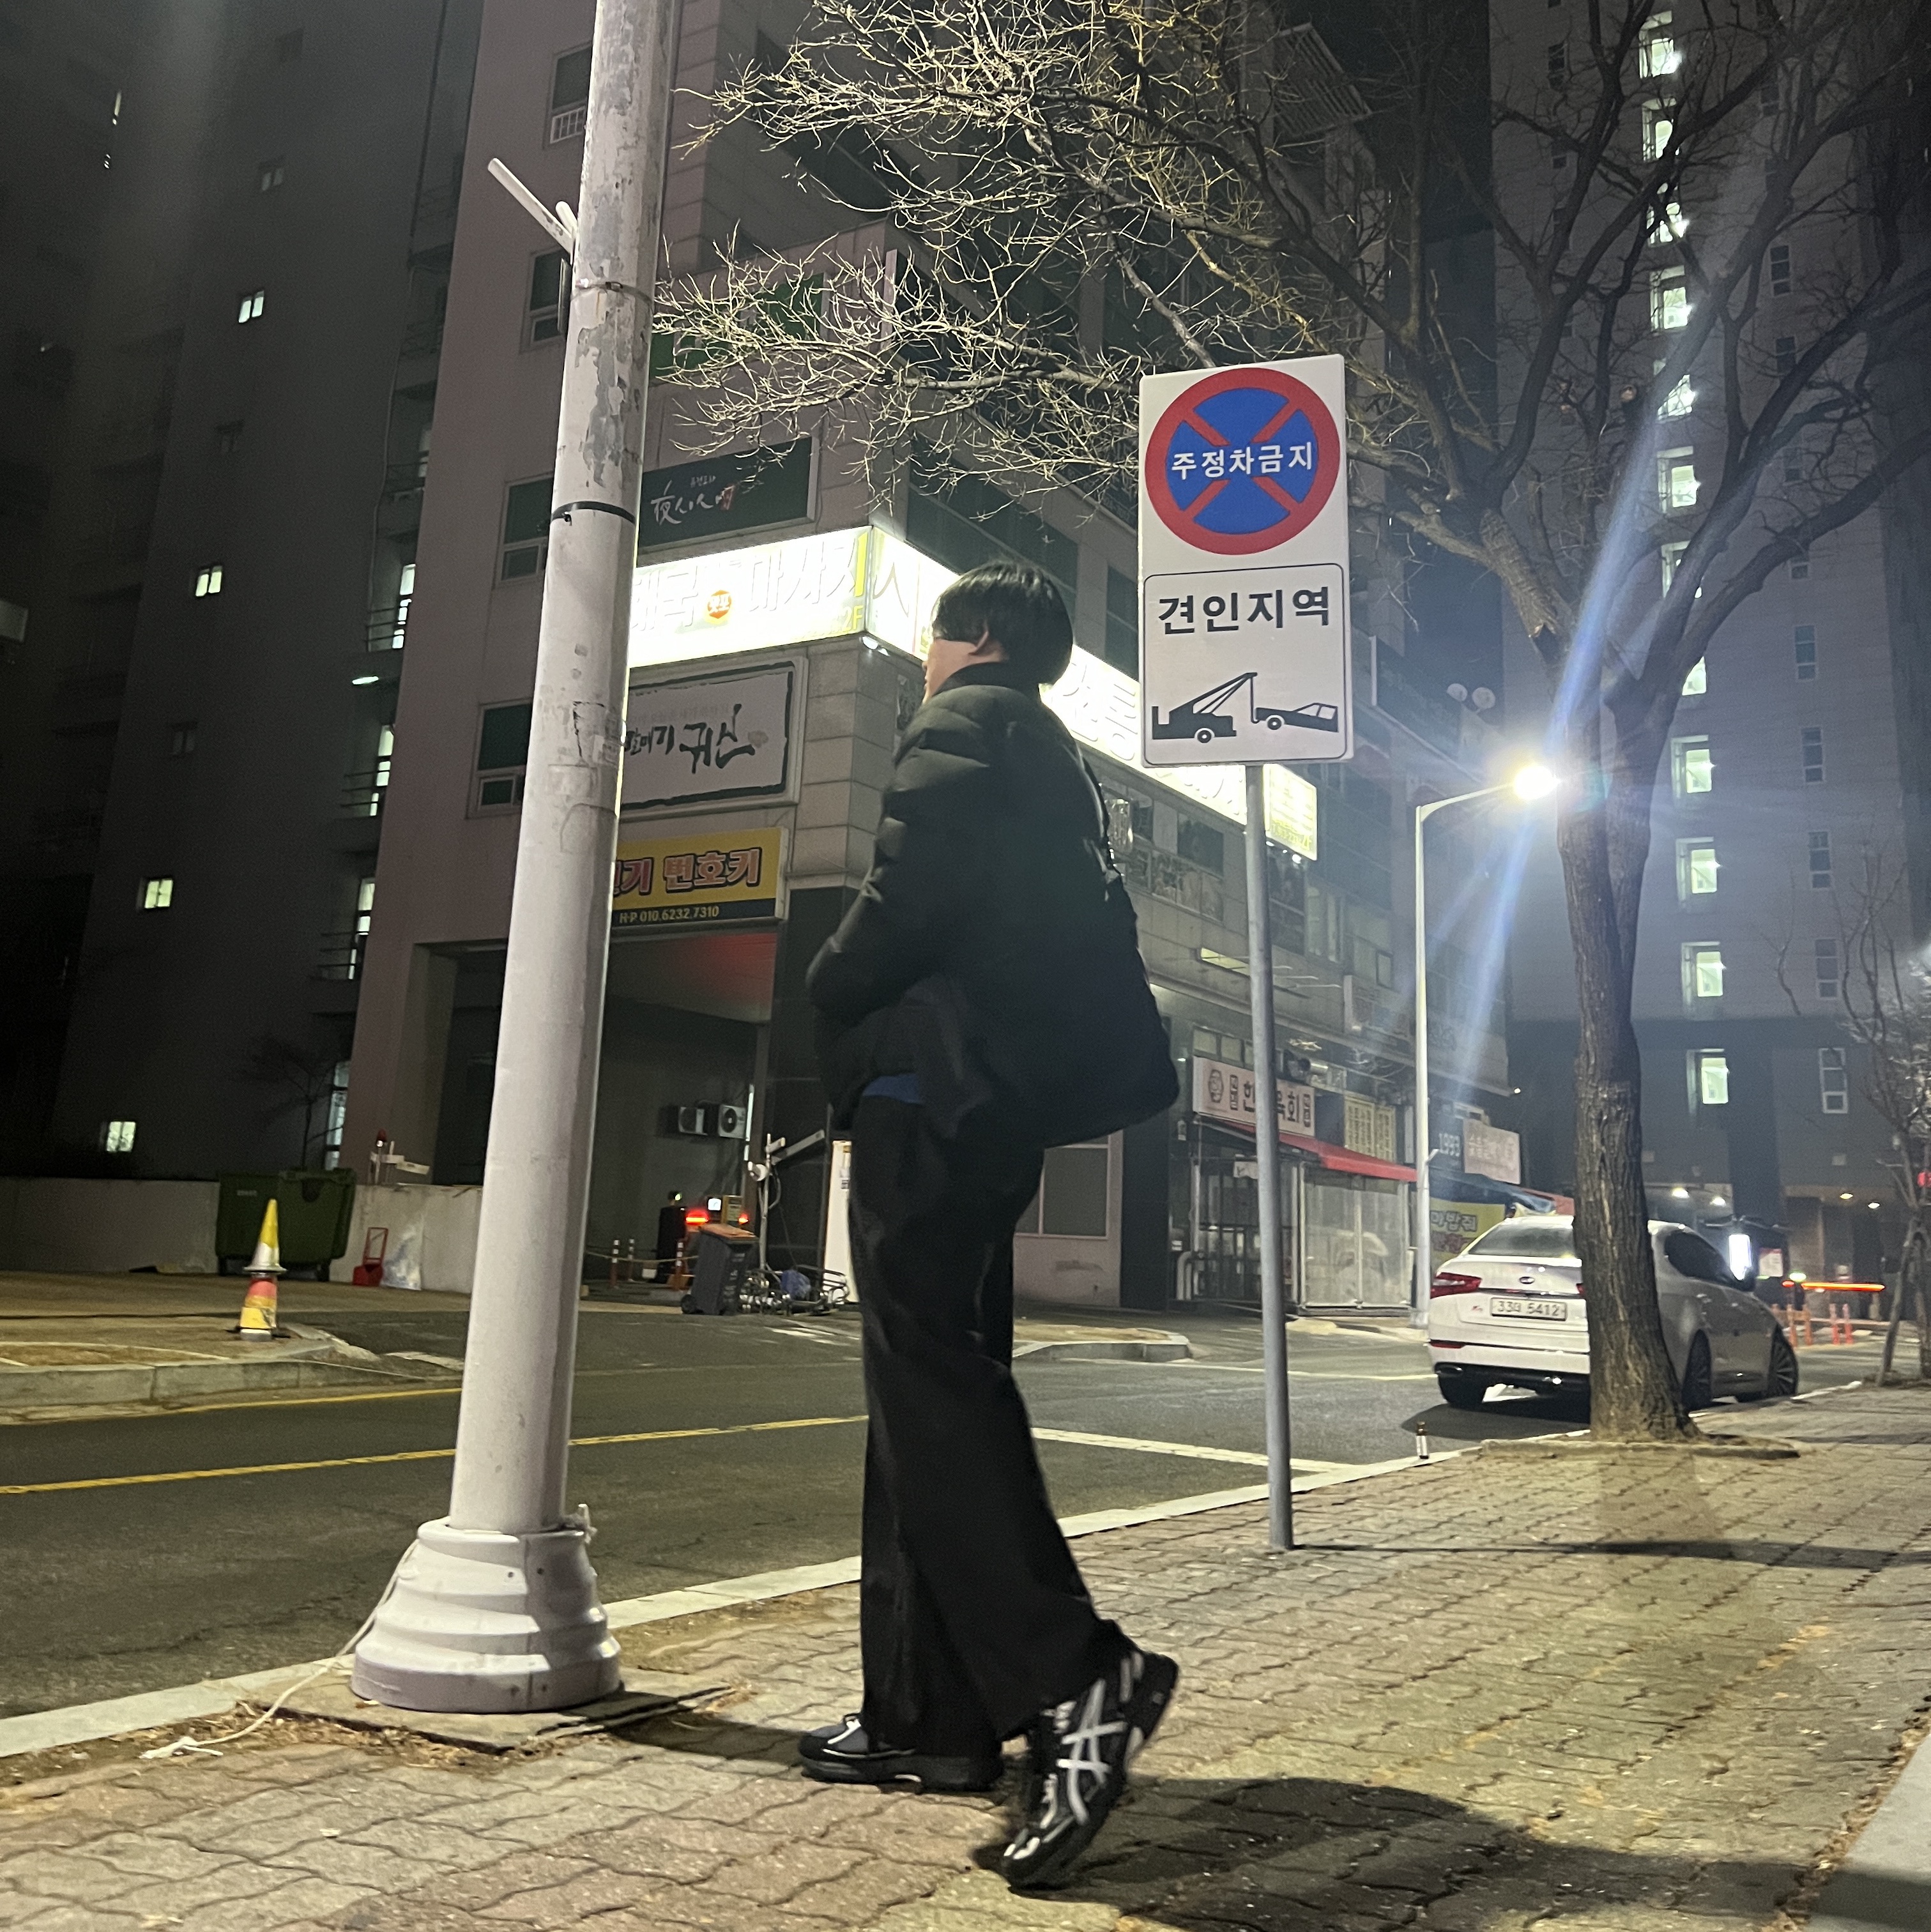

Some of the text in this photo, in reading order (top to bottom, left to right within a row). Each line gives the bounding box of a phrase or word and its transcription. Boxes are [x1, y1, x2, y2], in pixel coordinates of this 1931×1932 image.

[1171, 442, 1313, 480] 주정차금지
[1158, 586, 1329, 635] 견인지역
[678, 703, 756, 775] 귀신
[663, 846, 763, 894] 번호키
[1527, 1302, 1560, 1316] 5412
